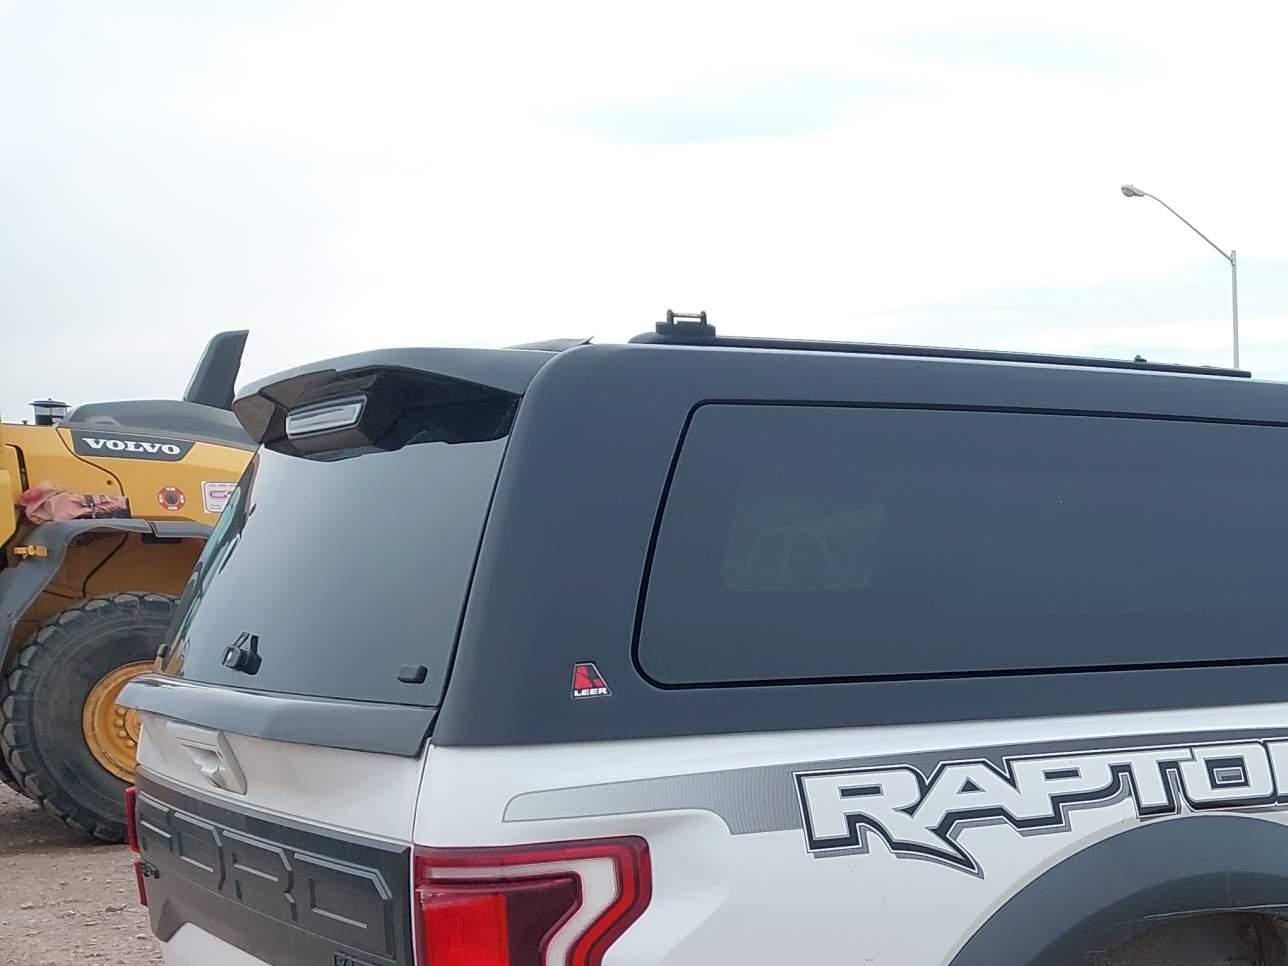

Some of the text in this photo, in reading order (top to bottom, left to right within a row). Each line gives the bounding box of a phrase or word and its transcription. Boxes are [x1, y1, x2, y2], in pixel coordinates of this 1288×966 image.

[82, 437, 181, 455] VOLVO
[574, 688, 607, 697] LEER
[137, 788, 396, 960] FORD
